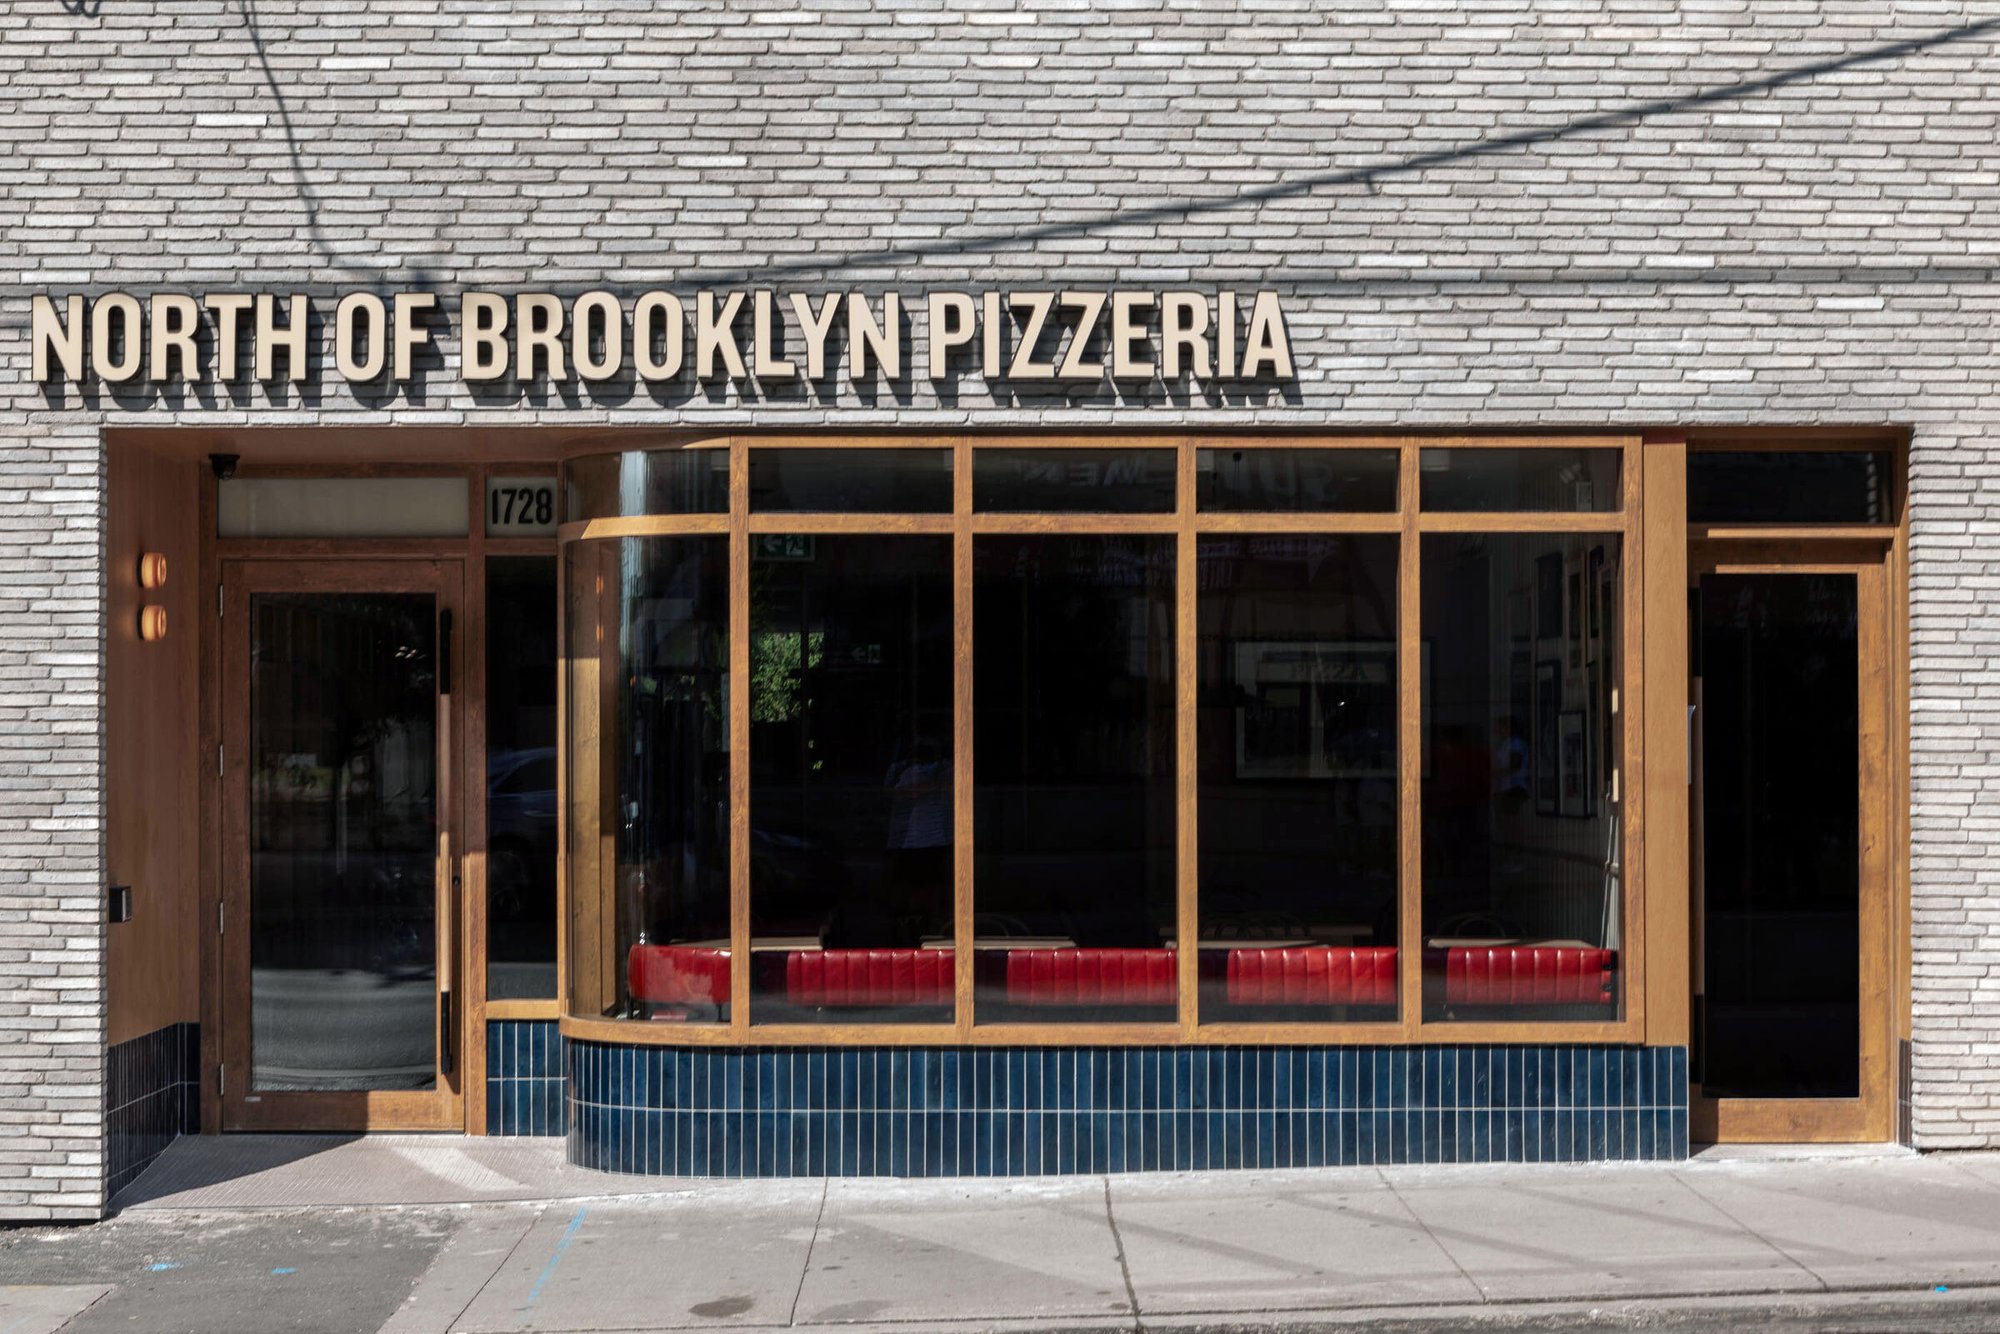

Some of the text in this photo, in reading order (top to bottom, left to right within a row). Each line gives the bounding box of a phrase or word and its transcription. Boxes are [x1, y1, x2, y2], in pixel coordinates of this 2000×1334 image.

[30, 290, 1294, 382] NORTH OF BROOKLYN PIZZERIA
[492, 487, 552, 525] 1728
